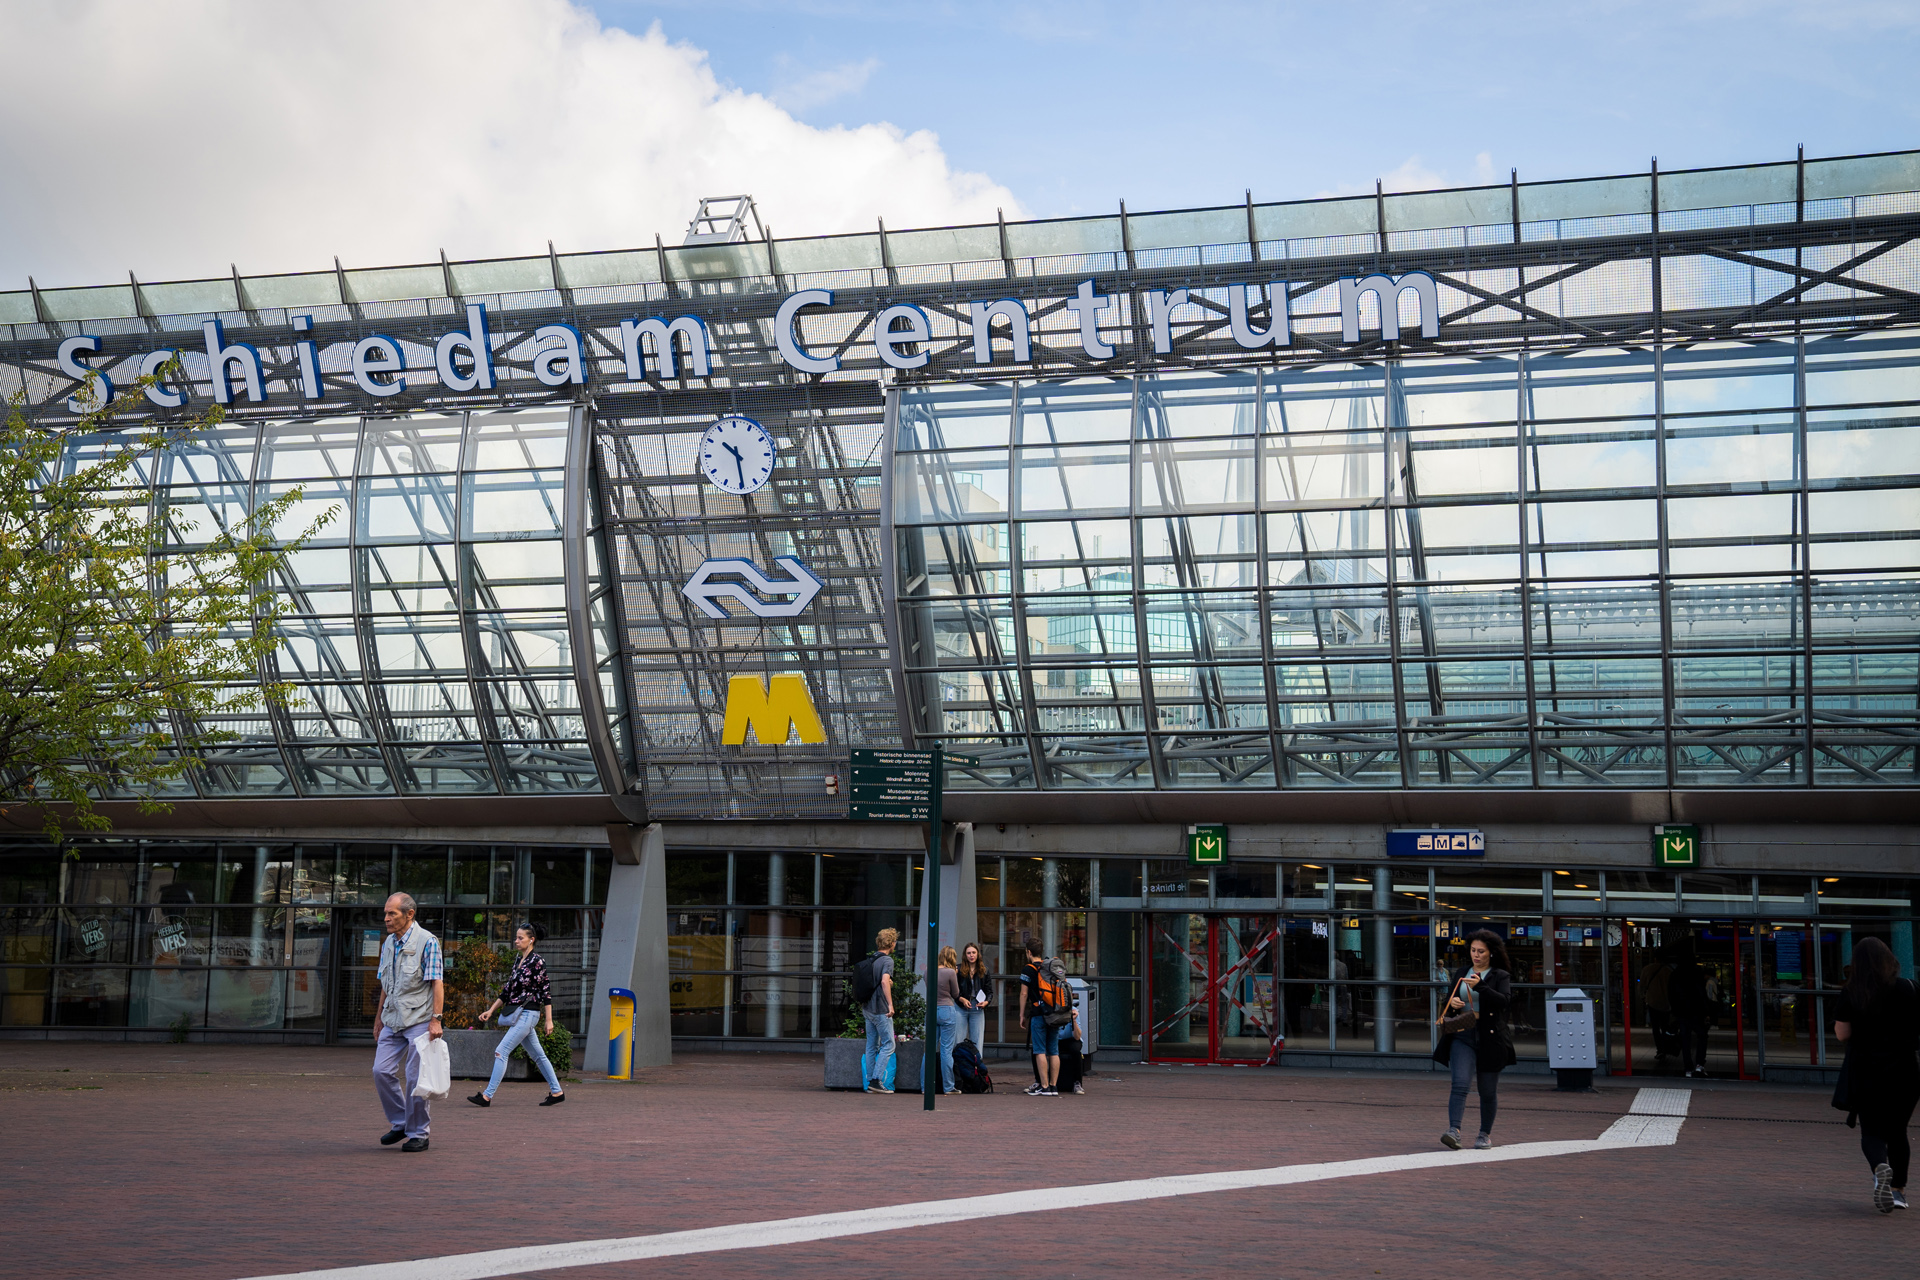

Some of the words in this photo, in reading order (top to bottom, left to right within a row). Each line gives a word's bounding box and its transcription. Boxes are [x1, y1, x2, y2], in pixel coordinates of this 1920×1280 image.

[57, 303, 712, 415] Schiedam
[774, 271, 1440, 373] Centrum
[722, 674, 827, 744] M
[82, 927, 105, 946] VERS
[157, 922, 184, 938] HEERLIJK
[85, 940, 107, 954] GEBAKKEN
[160, 931, 187, 953] VERS
